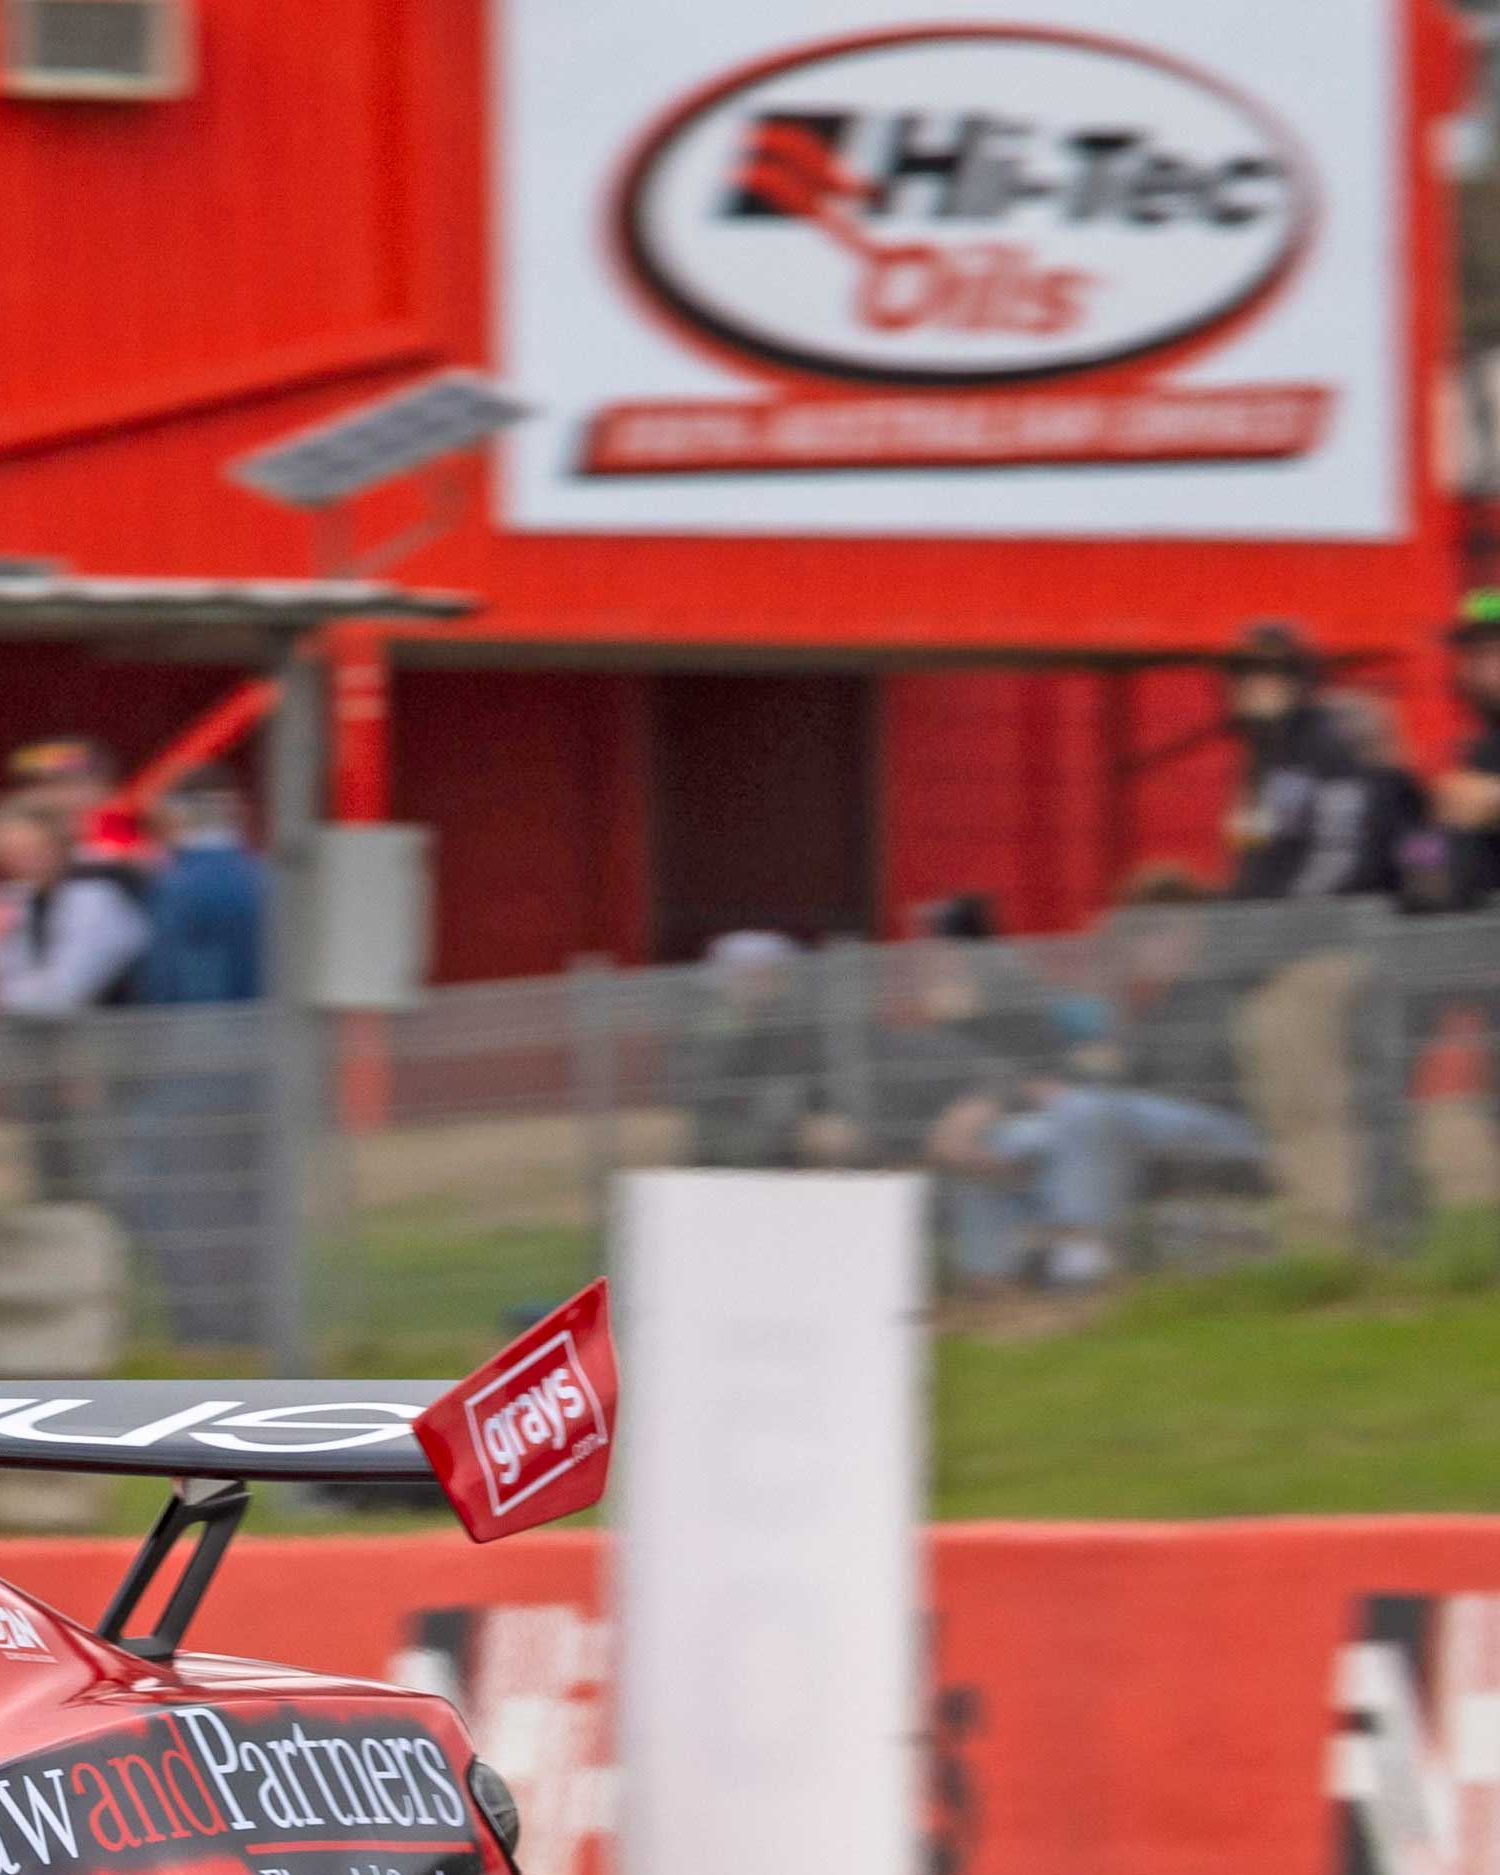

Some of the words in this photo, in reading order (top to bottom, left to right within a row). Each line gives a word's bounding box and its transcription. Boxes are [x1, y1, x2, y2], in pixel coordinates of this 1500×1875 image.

[876, 111, 1288, 228] Hi-Tec
[853, 244, 1088, 335] Oils
[483, 1368, 585, 1485] grays
